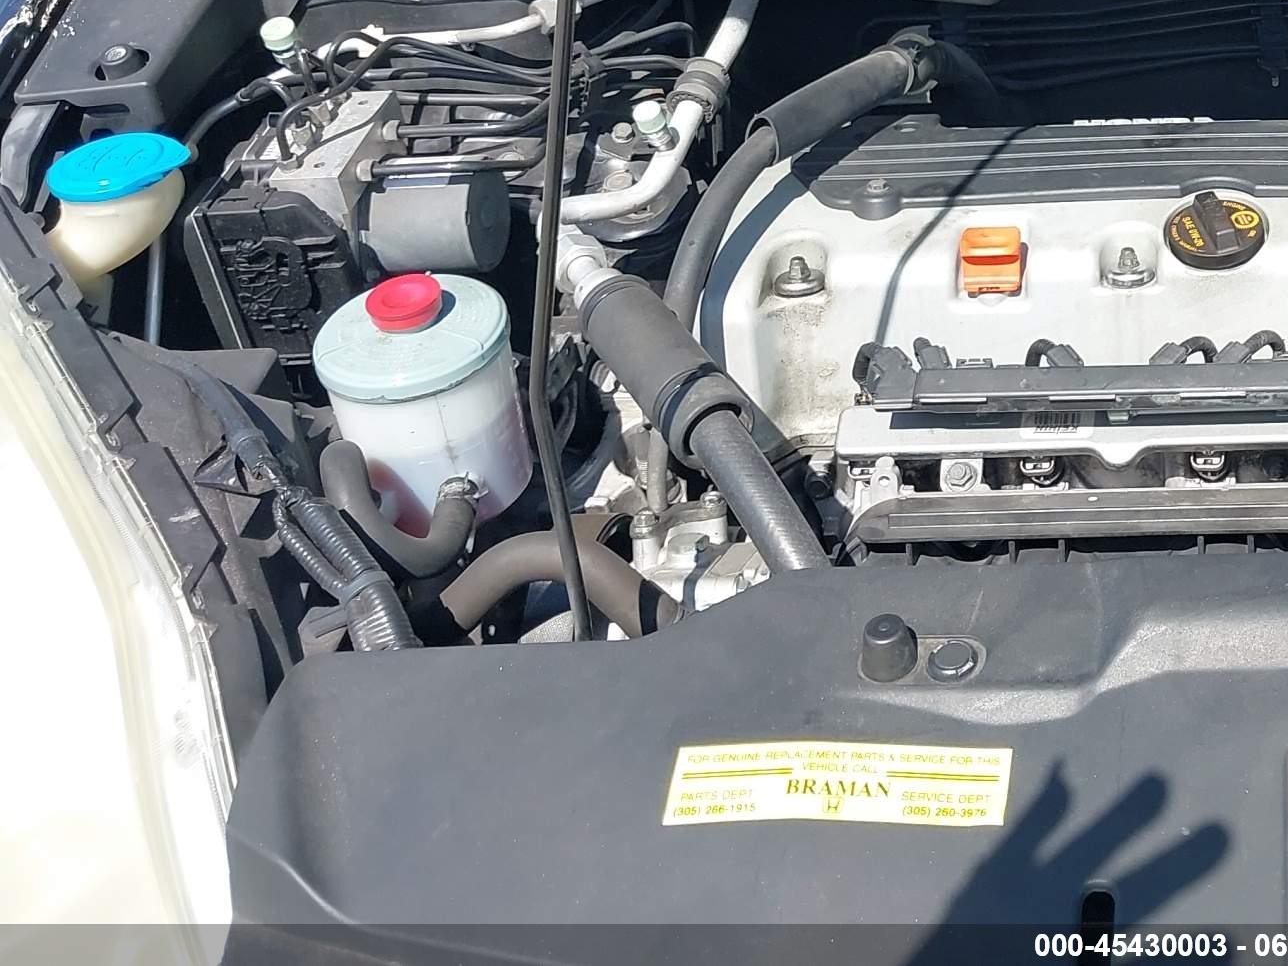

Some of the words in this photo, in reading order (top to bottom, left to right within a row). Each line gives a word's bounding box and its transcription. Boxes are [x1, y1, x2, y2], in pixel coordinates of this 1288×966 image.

[688, 753, 710, 763] FOR
[713, 752, 761, 763] GENUINE
[766, 750, 847, 761] REPLACEMENT
[852, 752, 885, 762] PARTS
[900, 754, 946, 764] SERVICE
[950, 756, 973, 765] FOR
[976, 756, 1000, 765] THIS
[802, 761, 848, 773] VEHICLE
[853, 763, 878, 774] CALL
[786, 778, 890, 797] BRAMAN
[681, 790, 717, 802] PARTS
[901, 791, 955, 803] SERVICE
[673, 806, 701, 817] (305)
[902, 806, 931, 818] (305)
